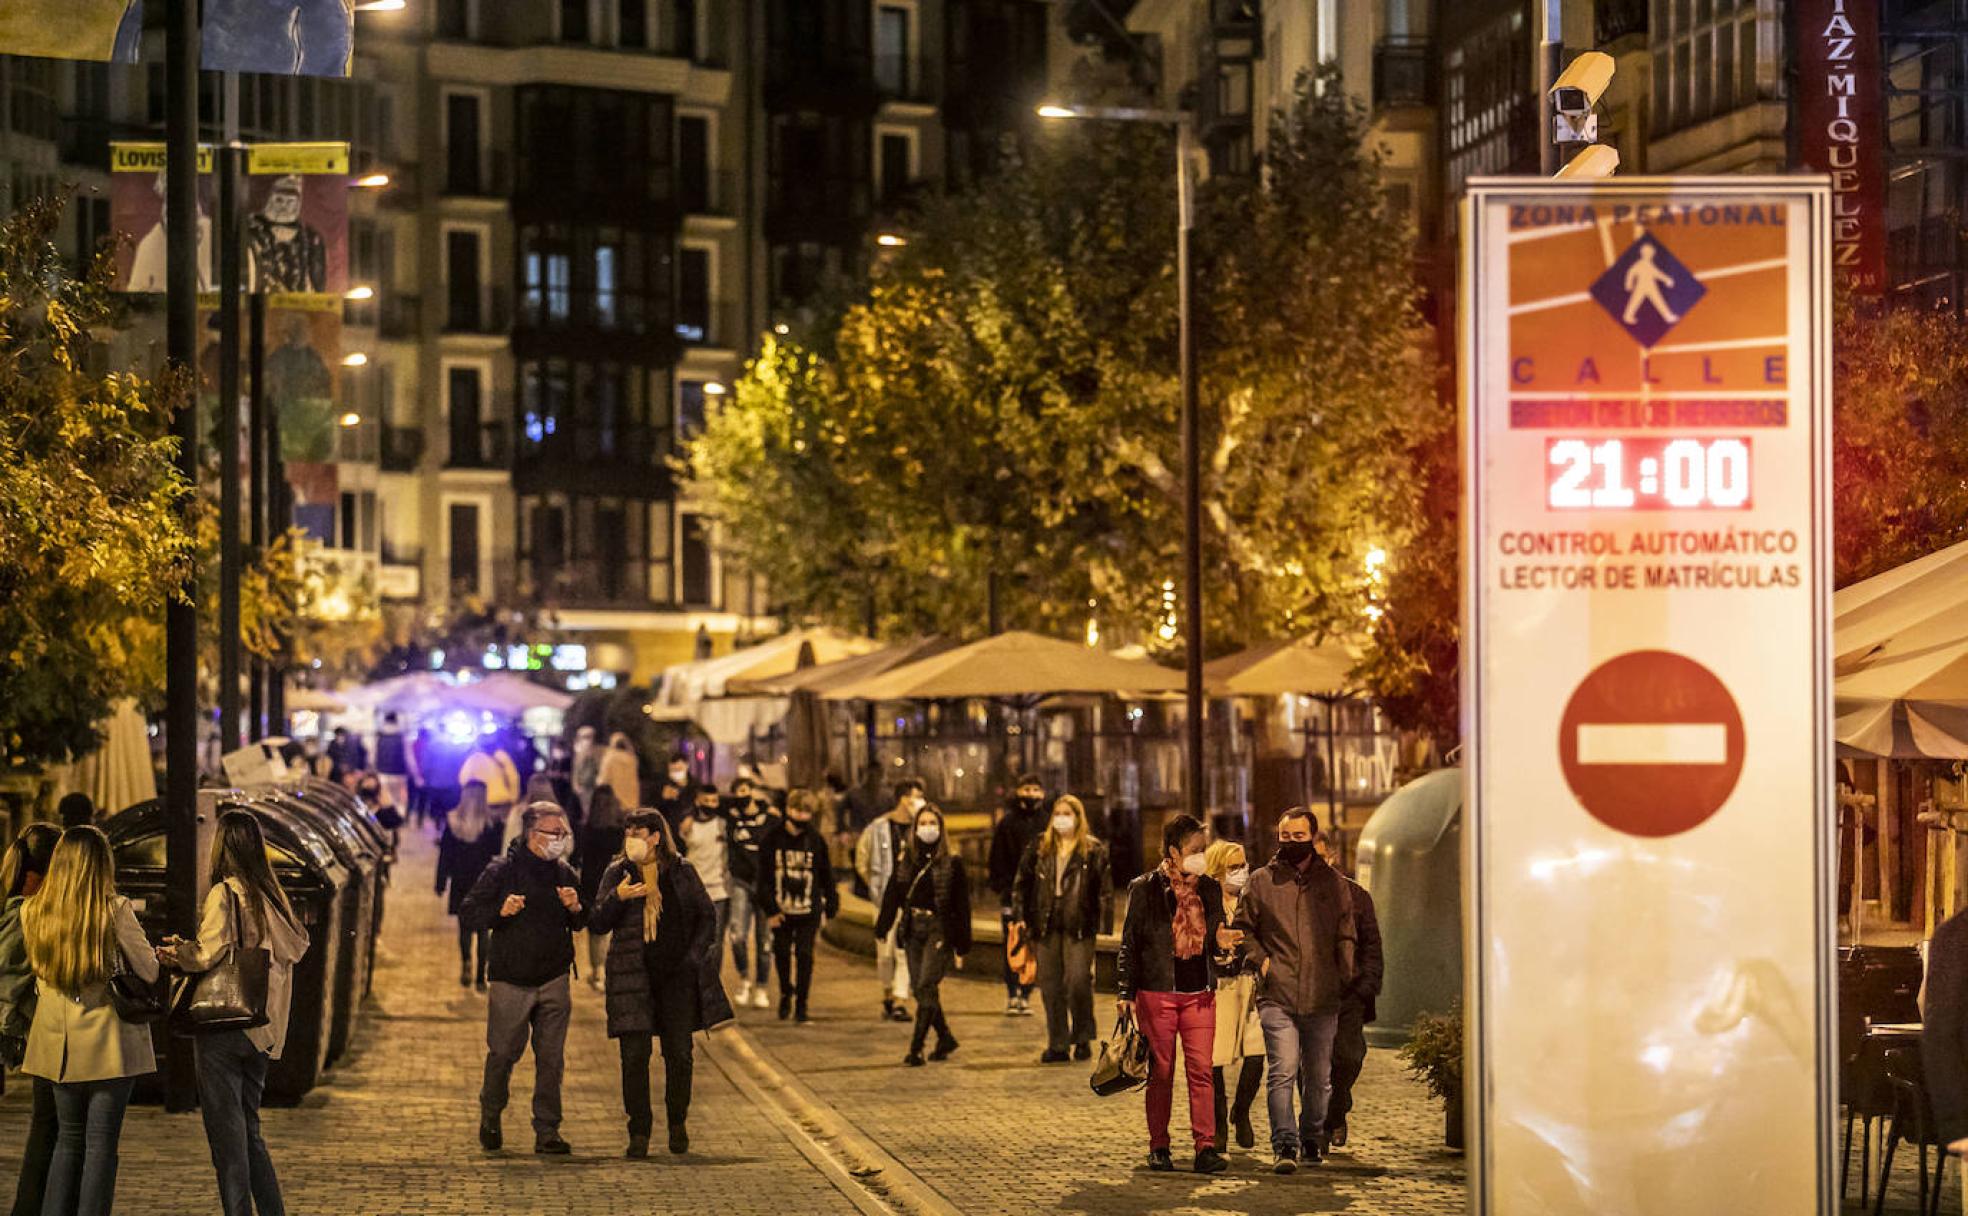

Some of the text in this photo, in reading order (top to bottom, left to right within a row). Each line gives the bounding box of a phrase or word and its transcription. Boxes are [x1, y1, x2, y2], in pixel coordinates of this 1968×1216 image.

[1510, 204, 1785, 227] ZONA PEATONAL
[1511, 356, 1785, 385] CALLE
[1549, 438, 1749, 507] 21:00
[1499, 525, 1797, 555] CONTROL AUTOMÁTICO
[1500, 560, 1801, 590] LECTOR DE MATRÍCULAS
